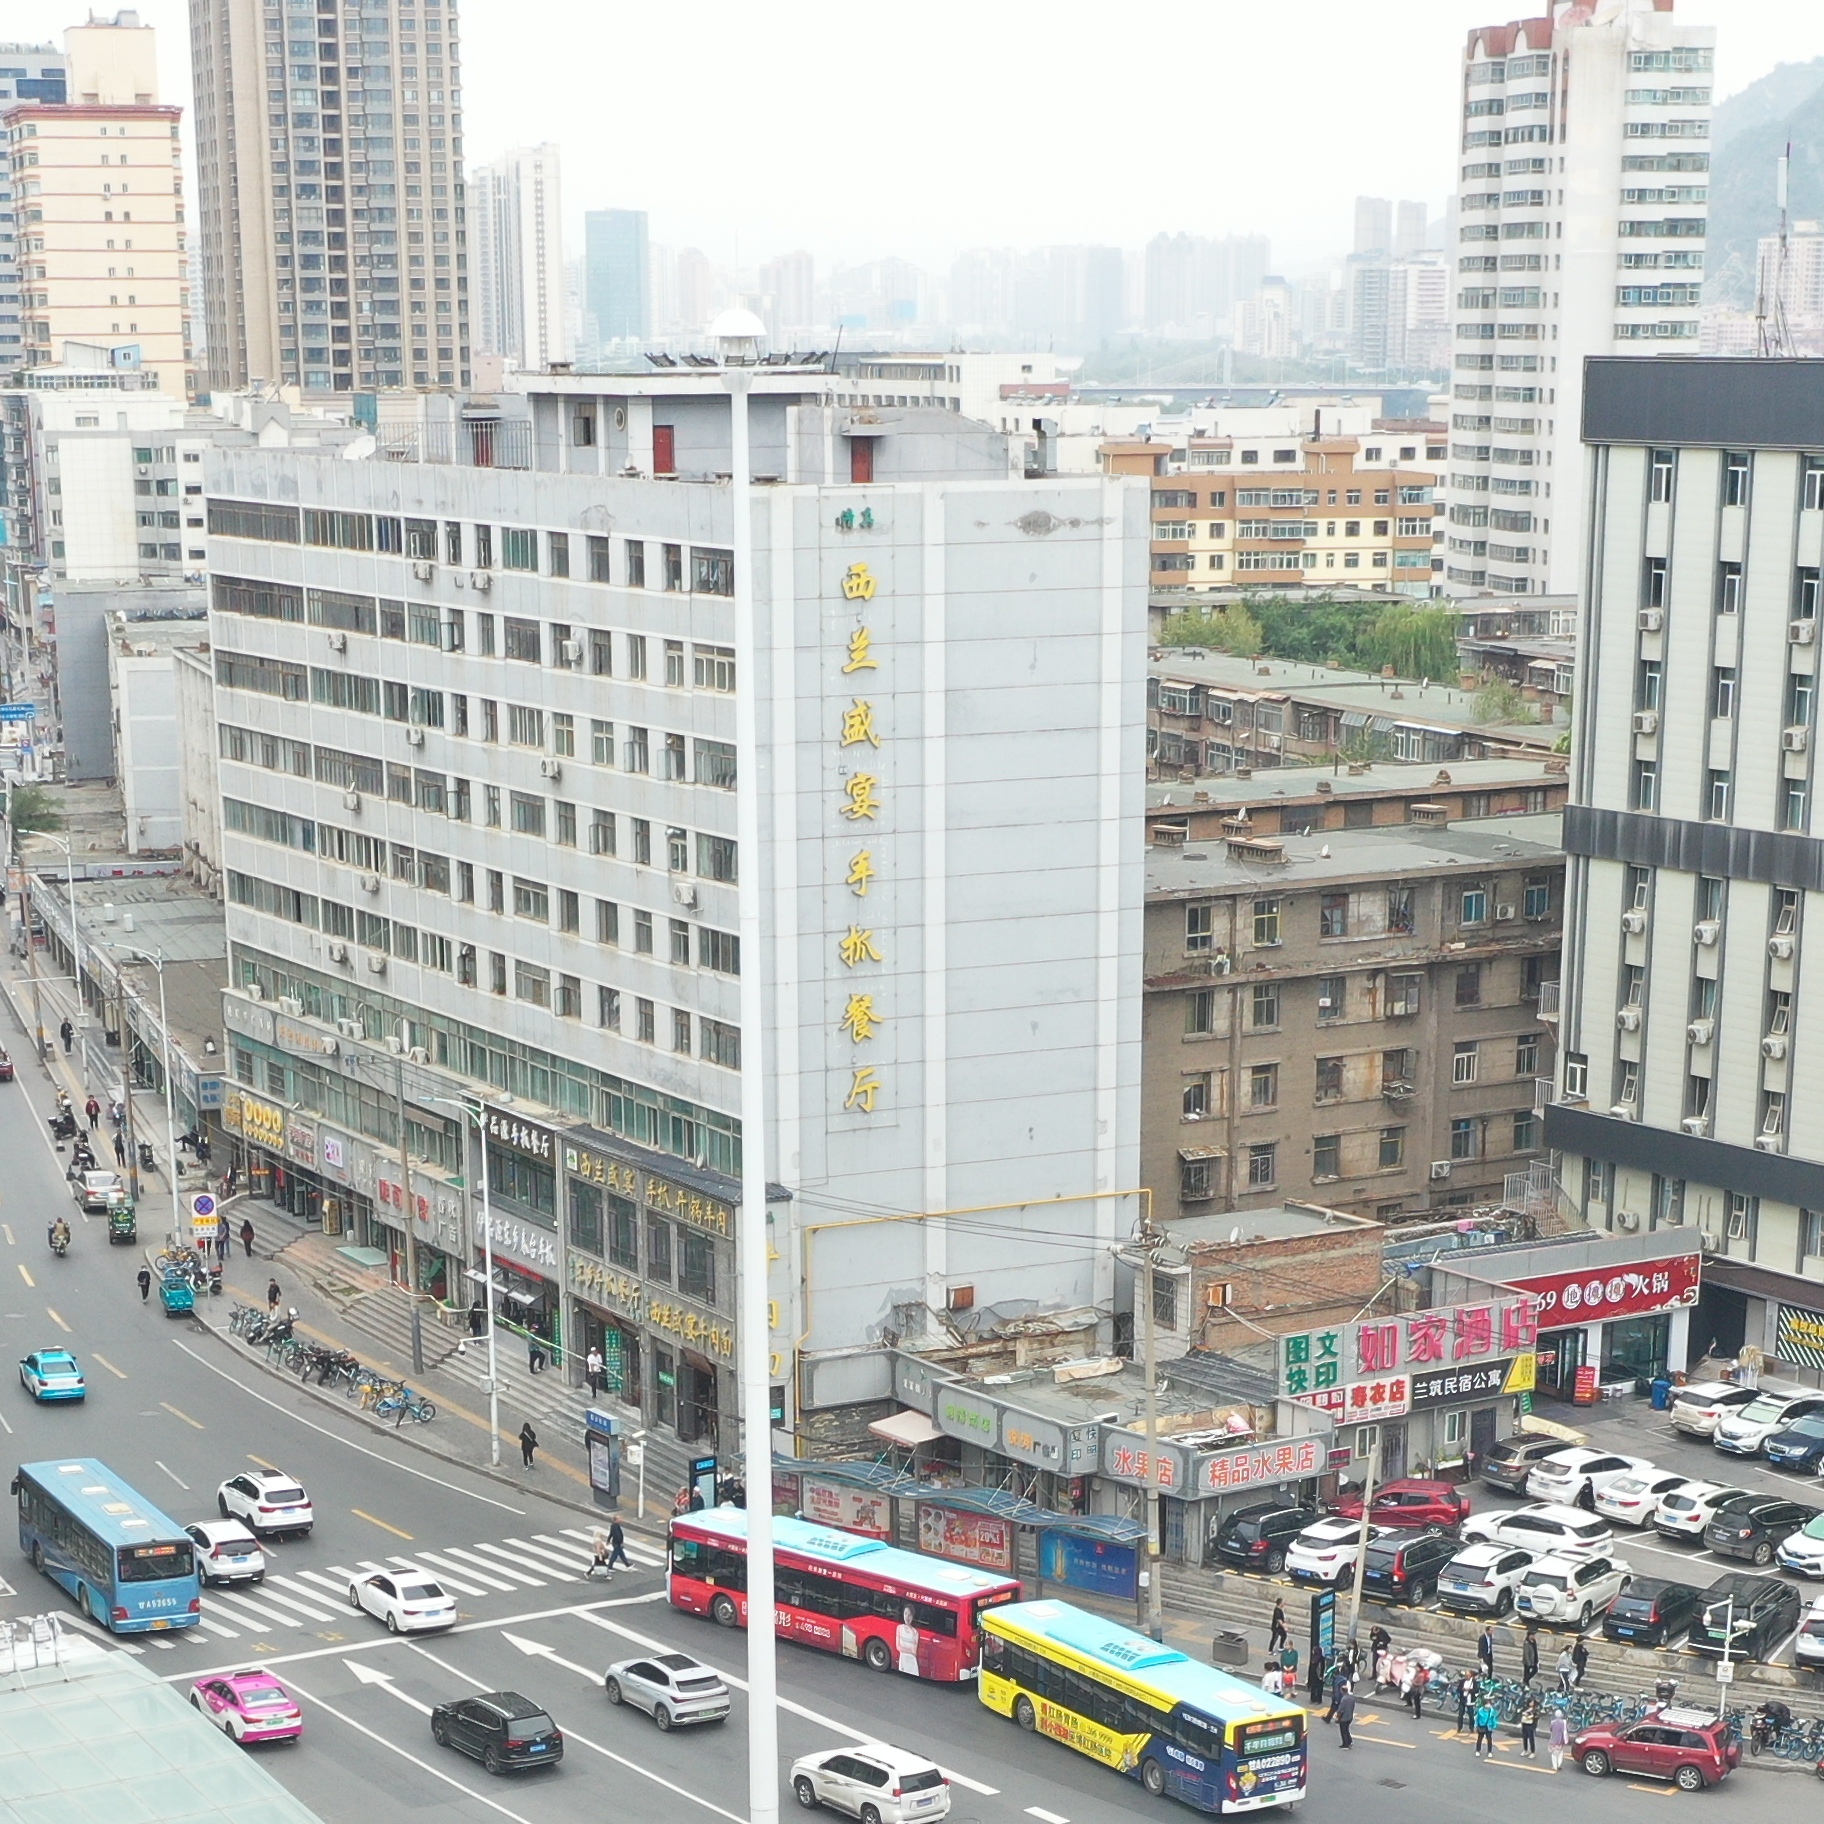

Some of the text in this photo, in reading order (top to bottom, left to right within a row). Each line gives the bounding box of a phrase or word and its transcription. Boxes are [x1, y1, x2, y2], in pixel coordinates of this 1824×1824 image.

[840, 562, 882, 1114] 西兰盛宴手抓餐厅
[1286, 1331, 1342, 1365] 图文
[1356, 1294, 1538, 1374] 如家酒店
[1286, 1361, 1338, 1395] 快印
[1351, 1379, 1406, 1408] 寿衣店
[1414, 1369, 1501, 1400] 兰筑民宿公寓
[1113, 1446, 1174, 1487] 水果店
[1209, 1442, 1317, 1489] 精品水果店
